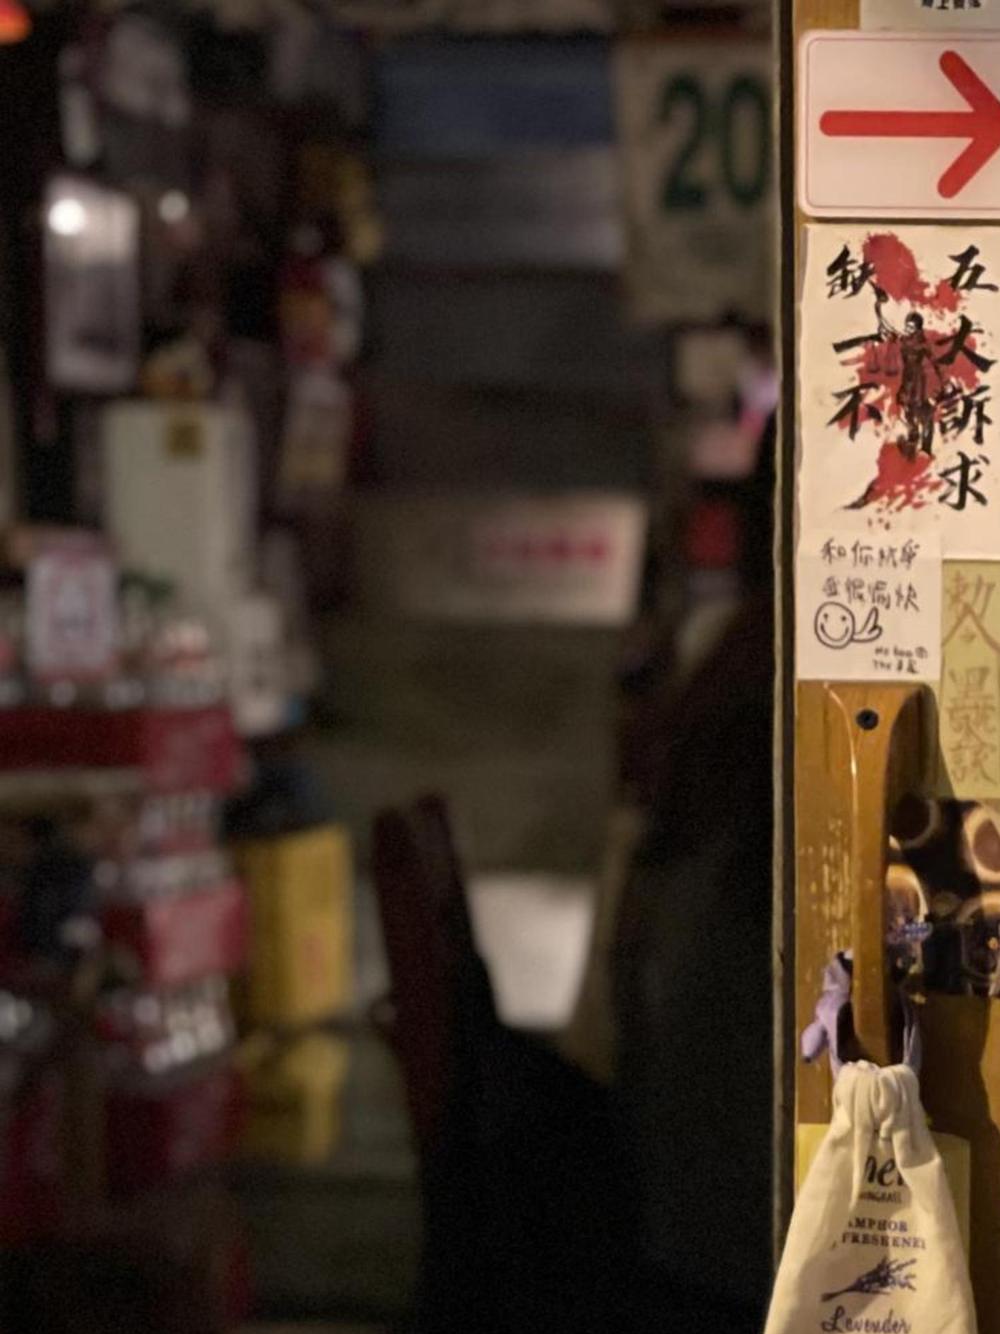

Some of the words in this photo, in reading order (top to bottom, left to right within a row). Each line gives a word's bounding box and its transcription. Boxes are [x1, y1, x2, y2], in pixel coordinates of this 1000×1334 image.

[657, 70, 773, 210] 20
[938, 244, 1000, 511] 五大訴求
